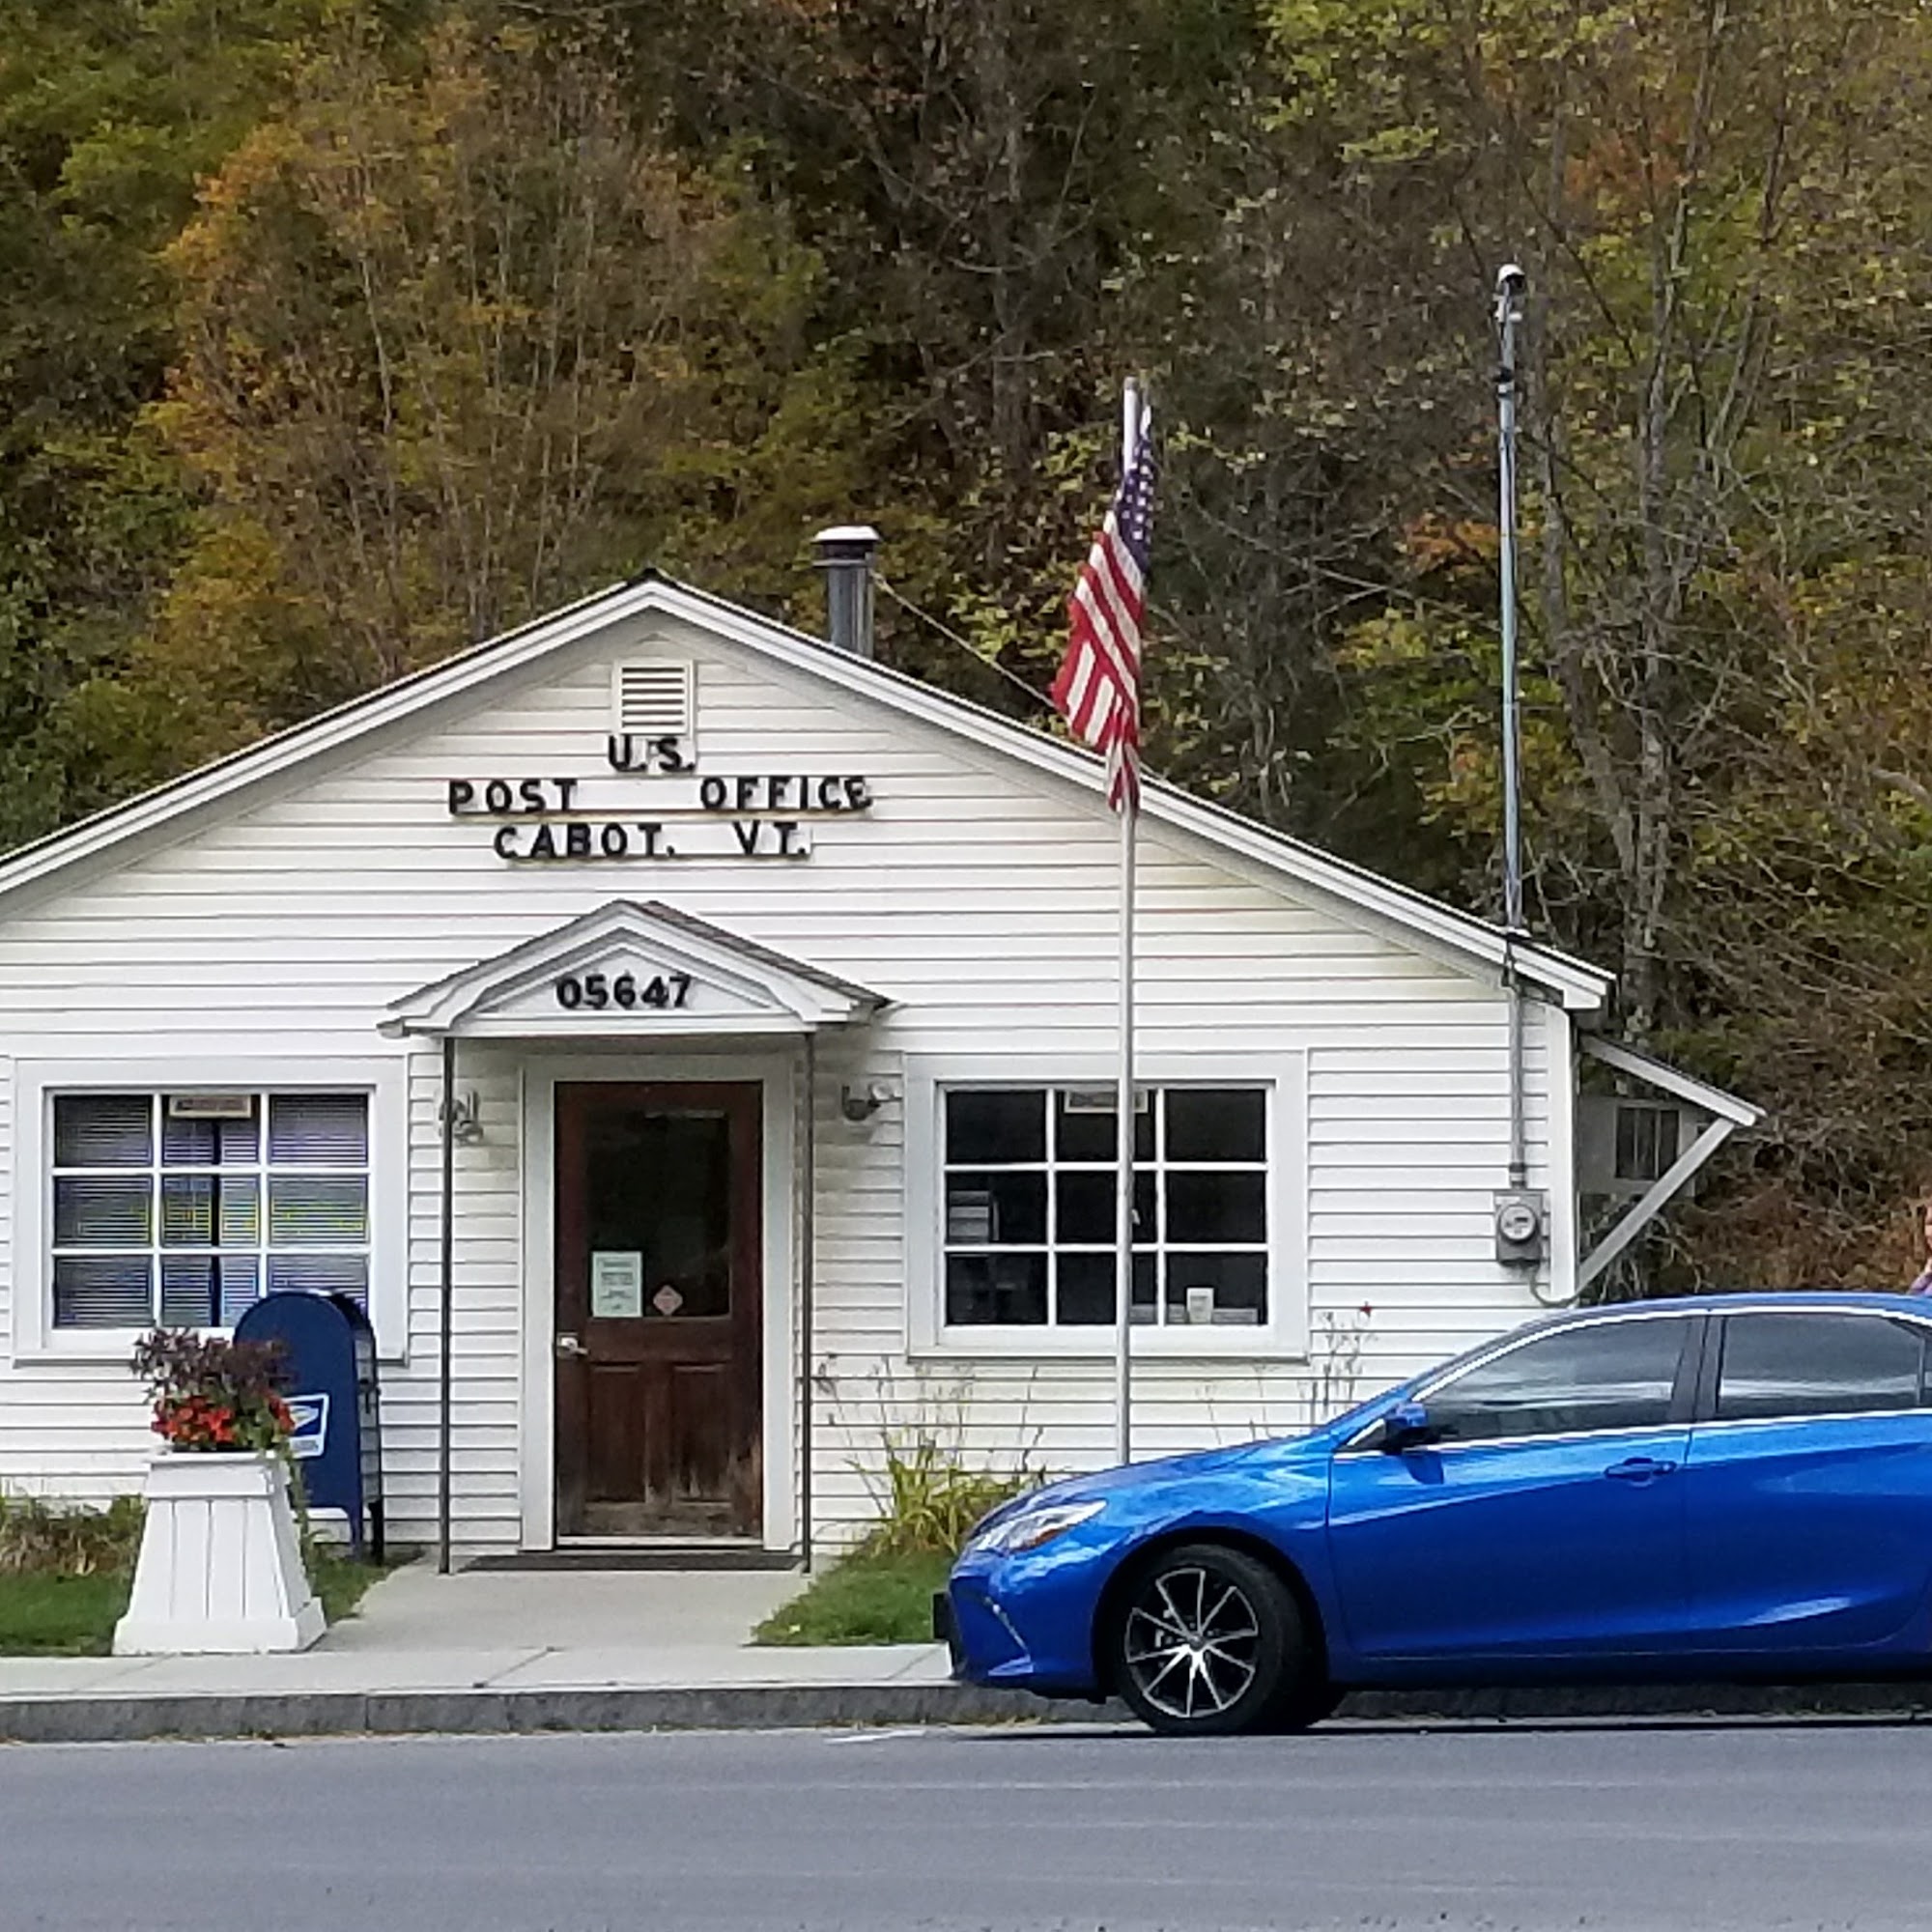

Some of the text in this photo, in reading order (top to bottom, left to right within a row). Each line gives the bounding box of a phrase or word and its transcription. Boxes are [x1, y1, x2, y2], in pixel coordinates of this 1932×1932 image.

[608, 734, 696, 772] U.S.
[448, 775, 874, 814] POST OFFICE
[732, 819, 807, 855] VT.
[555, 973, 692, 1010] 05647
